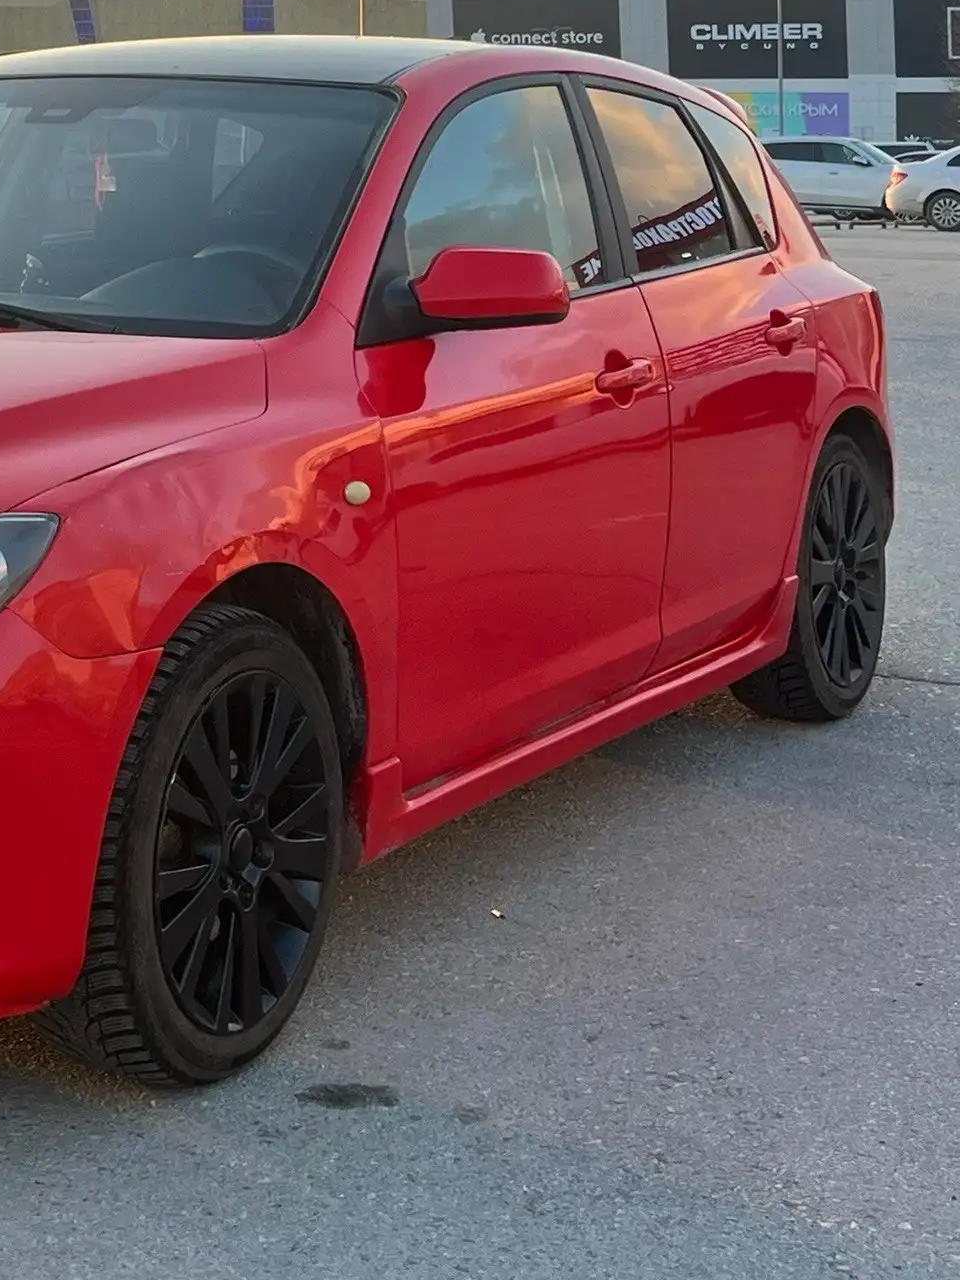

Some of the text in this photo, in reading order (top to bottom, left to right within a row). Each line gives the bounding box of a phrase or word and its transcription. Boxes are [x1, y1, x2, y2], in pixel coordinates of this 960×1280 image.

[491, 30, 603, 45] connect store
[690, 23, 823, 40] CLIMBER
[789, 102, 838, 118] КРЫМ
